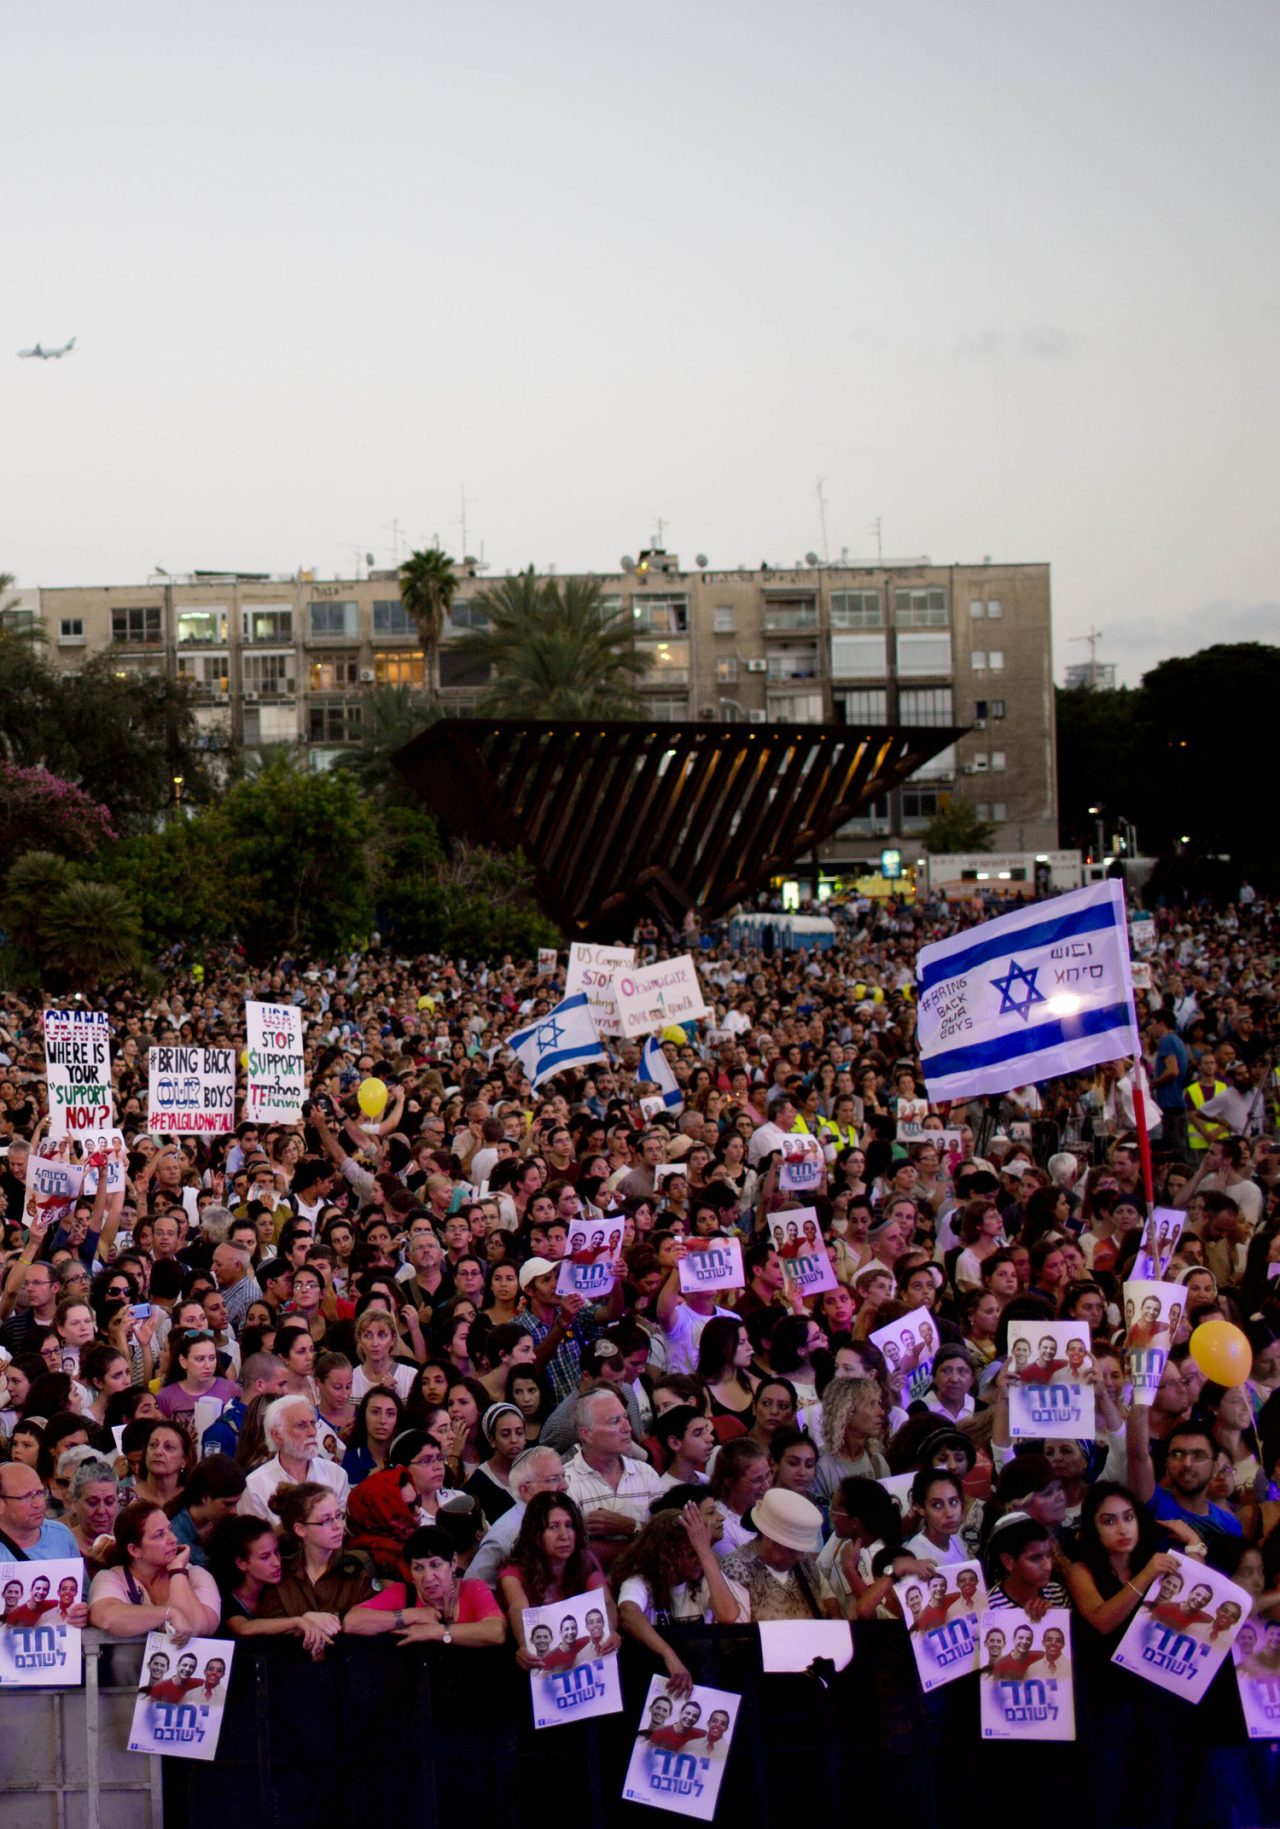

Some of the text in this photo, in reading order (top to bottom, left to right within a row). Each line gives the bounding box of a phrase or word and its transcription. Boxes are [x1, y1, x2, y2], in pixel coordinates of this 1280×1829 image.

[577, 946, 592, 963] US
[922, 977, 967, 1012] #BRING
[937, 993, 968, 1018] BACK
[47, 1041, 105, 1064] WHERE IS
[262, 1031, 295, 1050] STOP
[150, 1047, 232, 1074] #BRING BACK
[248, 1047, 305, 1078] $UPPORT
[65, 1064, 99, 1084] YOUR
[275, 1075, 281, 1086] 2
[157, 1076, 233, 1110] OUR BOYS
[250, 1083, 301, 1109] TERROR
[66, 1105, 110, 1129] NOW?
[790, 1162, 818, 1176] יחד
[791, 1173, 817, 1184] לשובם
[576, 1261, 612, 1280] יחד
[692, 1248, 732, 1269] יחד
[787, 1253, 820, 1275] יחד
[574, 1277, 609, 1290] לשובם
[696, 1264, 733, 1281] לשובם
[1028, 1382, 1080, 1409] יחד
[1031, 1405, 1081, 1423] לשובם
[13, 1624, 67, 1652] יחד
[927, 1612, 978, 1650] יחד
[1154, 1621, 1211, 1660] יחד
[14, 1649, 67, 1669] לשובם
[1142, 1646, 1199, 1681] לשובם
[551, 1658, 604, 1694] יחד
[556, 1681, 606, 1711] לשובם
[1001, 1678, 1058, 1705] יחד
[156, 1702, 210, 1728] יחד
[1004, 1703, 1059, 1721] לשובם
[154, 1727, 206, 1743] לשובם
[654, 1748, 710, 1780] יחד
[650, 1774, 704, 1798] לשובם
